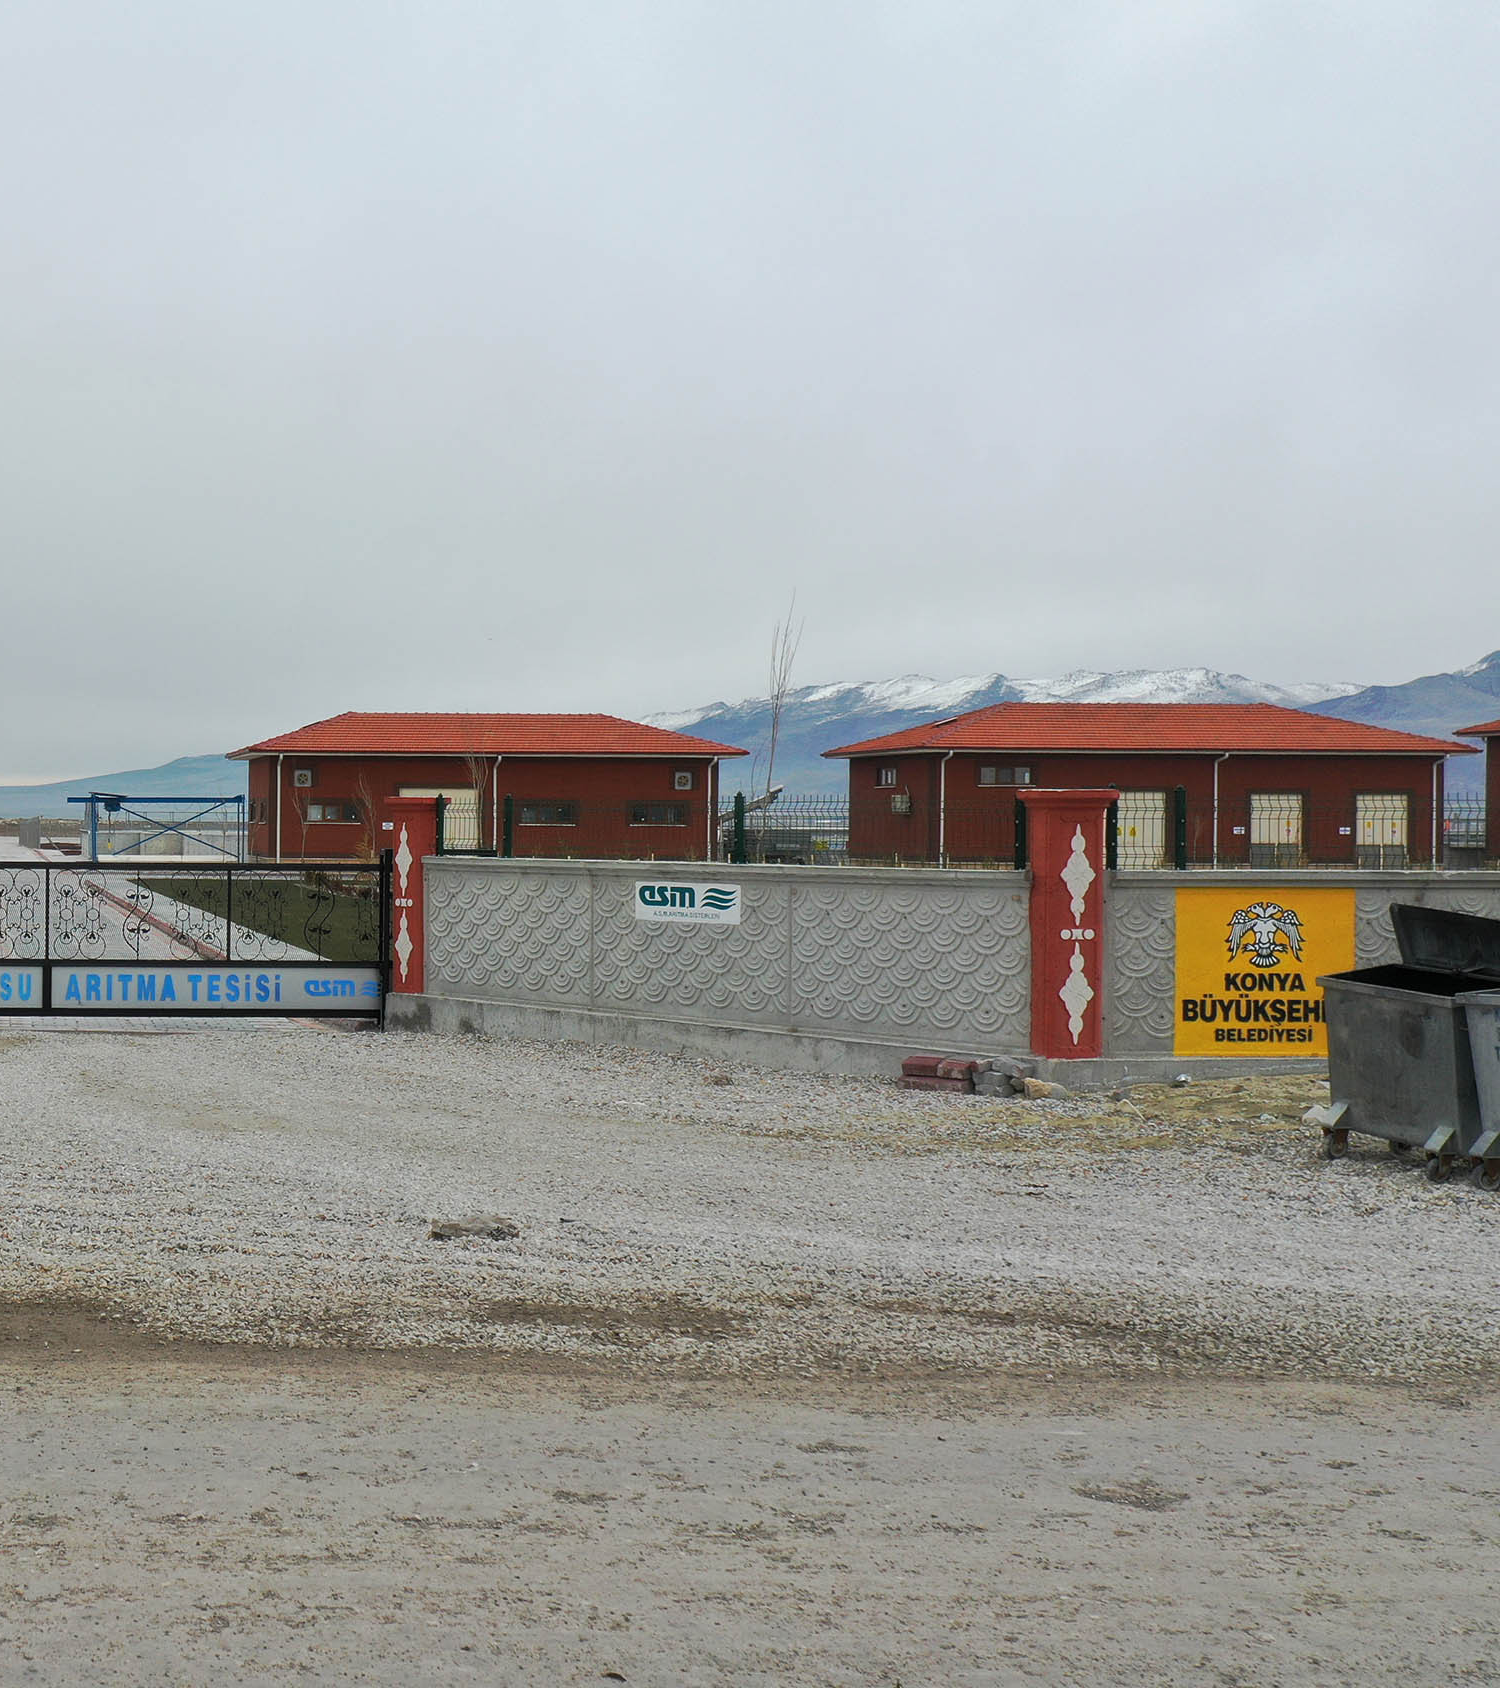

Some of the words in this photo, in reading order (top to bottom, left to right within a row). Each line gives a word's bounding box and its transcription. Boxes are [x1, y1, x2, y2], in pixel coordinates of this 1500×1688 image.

[65, 974, 177, 1001] ARITMA
[1224, 973, 1306, 992] KONYA
[1182, 993, 1327, 1027] BÜYÜKŞEH
[1214, 1024, 1313, 1043] BELEDİYESİ
